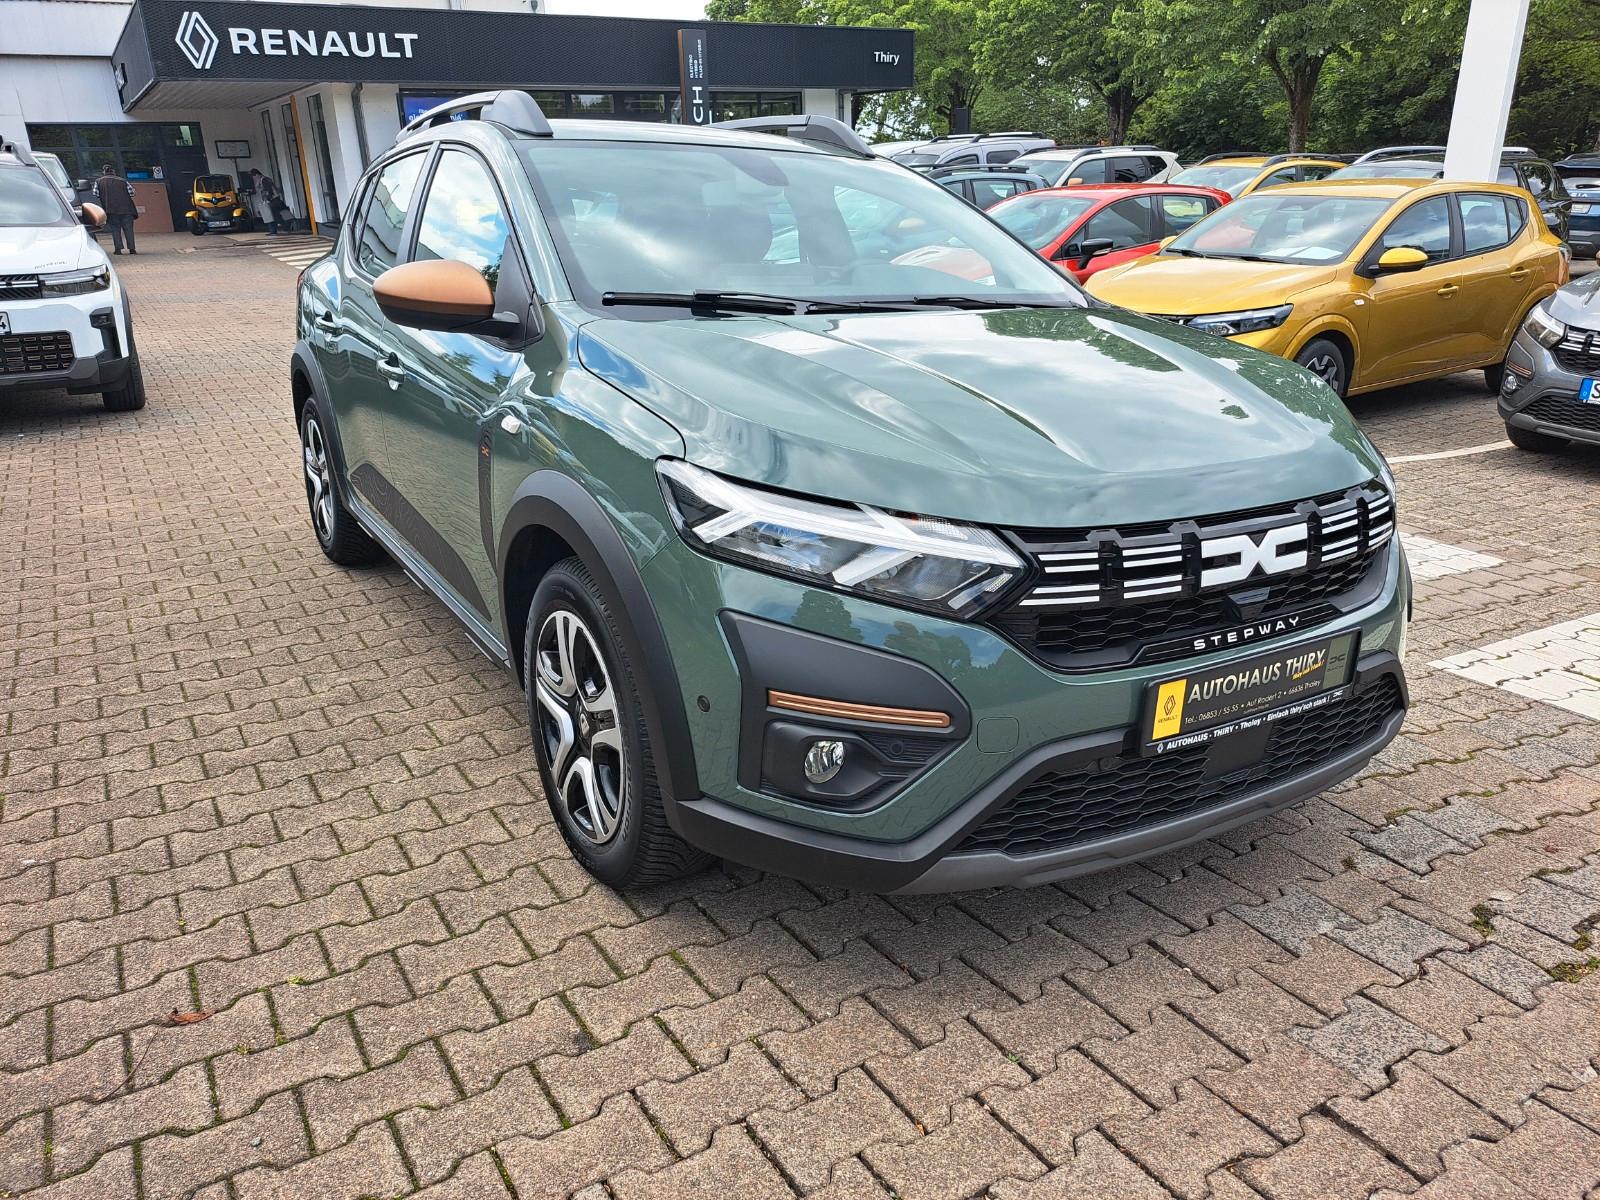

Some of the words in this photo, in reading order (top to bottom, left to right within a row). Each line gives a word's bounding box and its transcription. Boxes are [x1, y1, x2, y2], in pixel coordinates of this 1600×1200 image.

[228, 28, 418, 58] RENAULT
[873, 51, 900, 66] Thiry
[1193, 616, 1299, 650] STEPWAY
[1187, 662, 1282, 704] AUTOHAUS
[1286, 648, 1326, 677] THIRY
[1166, 733, 1208, 750] AUTOHAUS
[1213, 725, 1235, 738] THIRY
[1240, 718, 1261, 730] Tholey
[1267, 709, 1289, 721] Einfach
[1198, 710, 1218, 721] 06853
